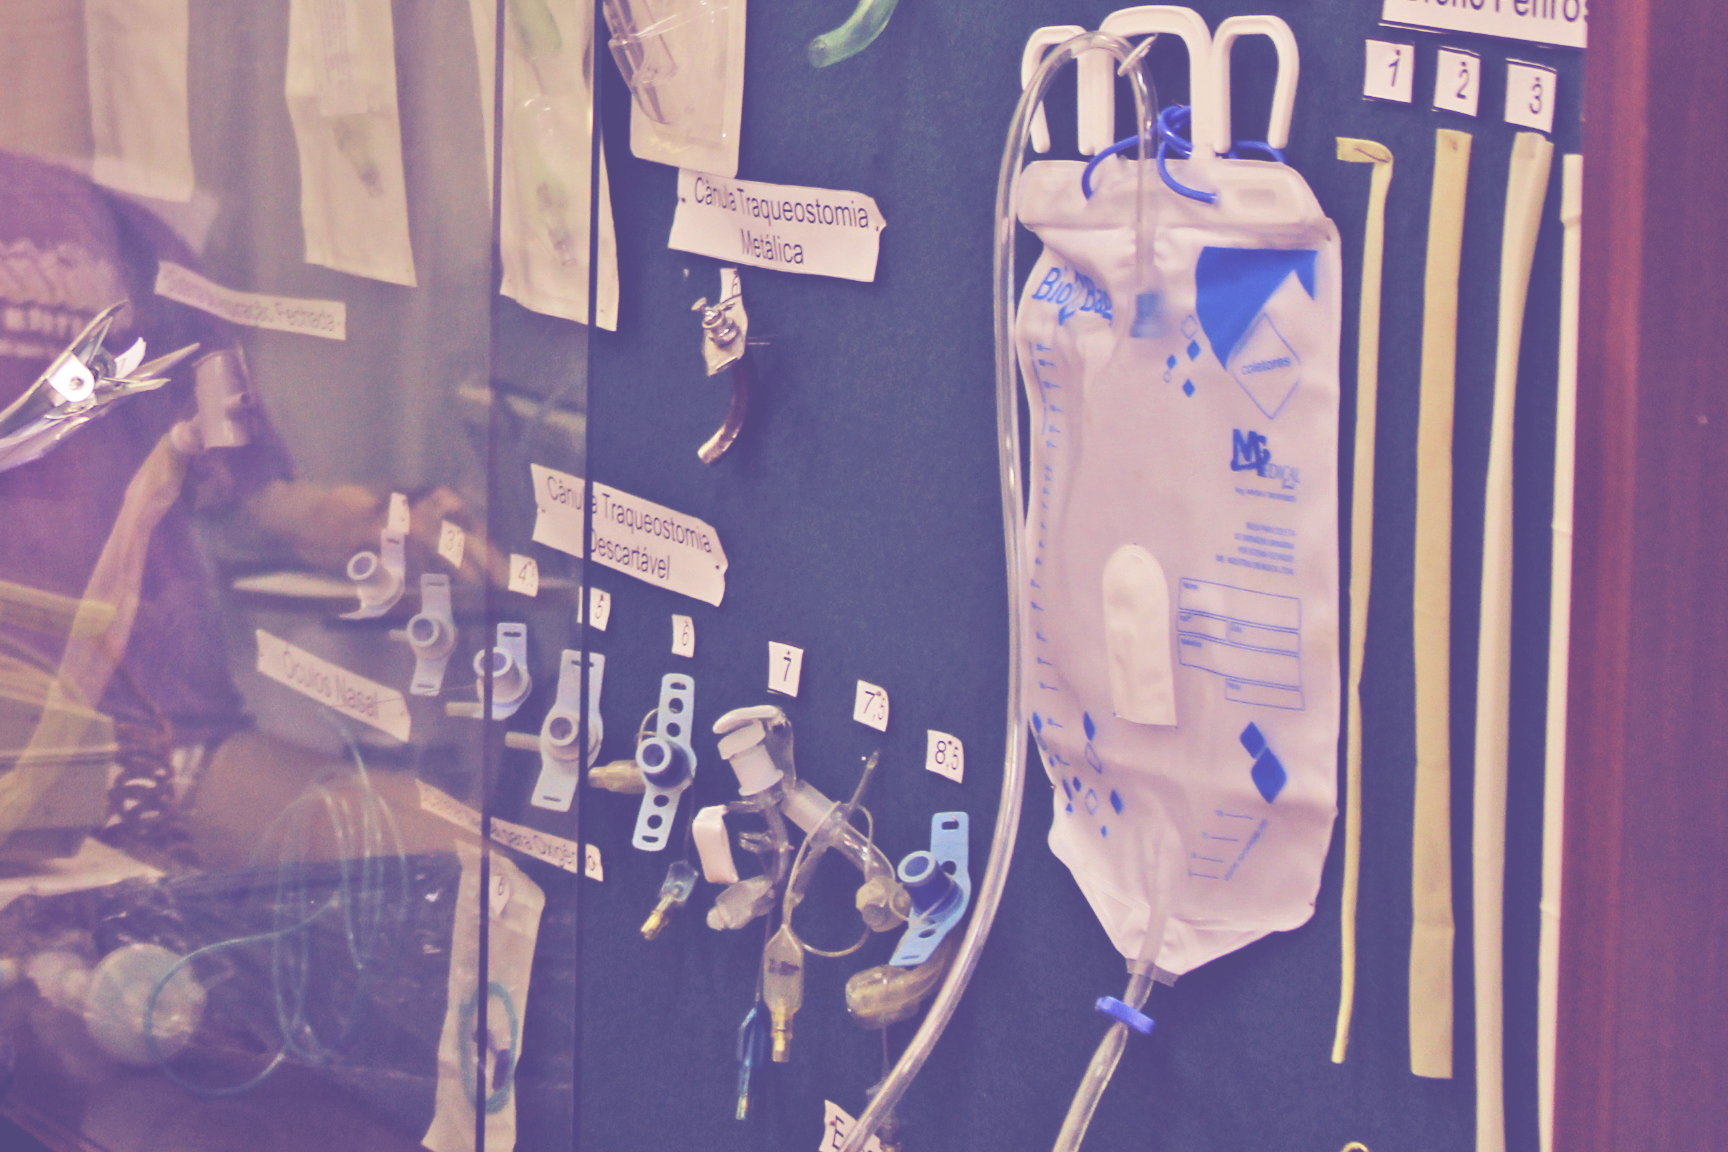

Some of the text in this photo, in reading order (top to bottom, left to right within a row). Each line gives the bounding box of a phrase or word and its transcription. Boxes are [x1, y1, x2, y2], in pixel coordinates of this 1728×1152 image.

[1388, 57, 1401, 88] 1
[1455, 68, 1470, 100] 2
[1528, 83, 1544, 115] 3
[694, 176, 870, 229] Cânula Traqueostomia
[740, 228, 805, 265] Metálica
[547, 475, 713, 554] Cânua Traqueostomia
[681, 623, 690, 647] 6
[783, 655, 793, 683] 7
